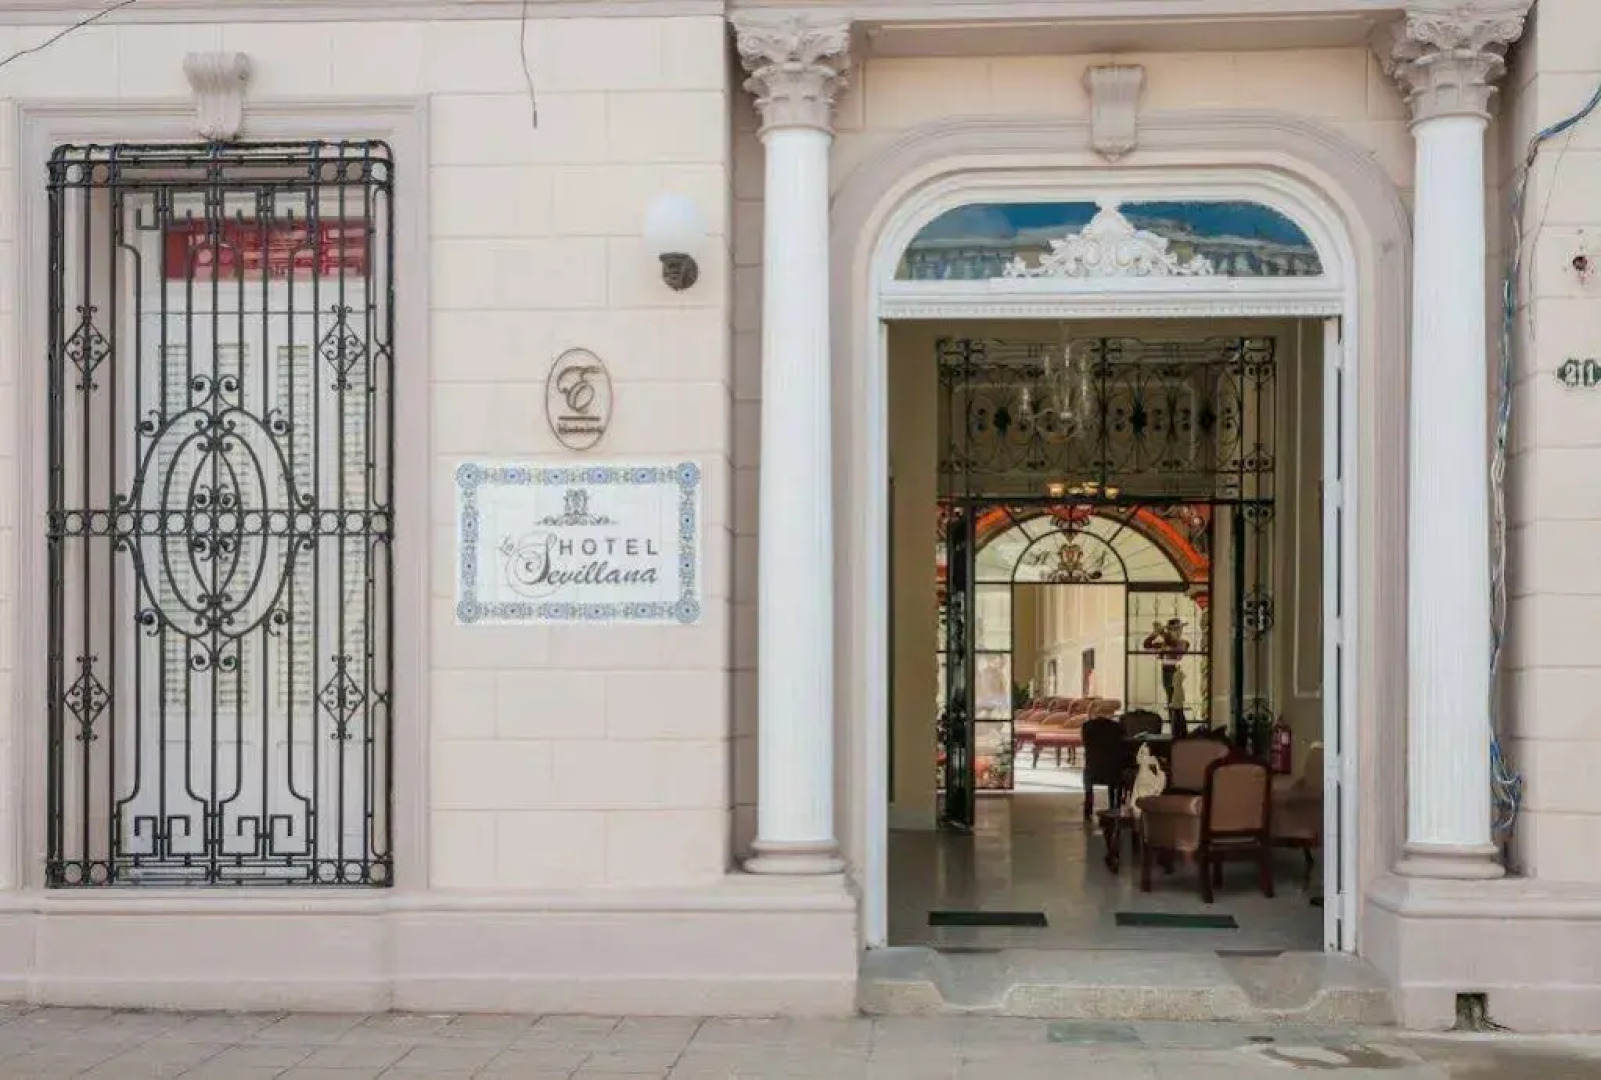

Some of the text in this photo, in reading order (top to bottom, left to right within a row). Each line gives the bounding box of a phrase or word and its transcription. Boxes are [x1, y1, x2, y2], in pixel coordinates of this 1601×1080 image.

[1564, 362, 1595, 384] 211
[558, 538, 659, 556] HOTEL
[505, 530, 658, 598] Sevillana
